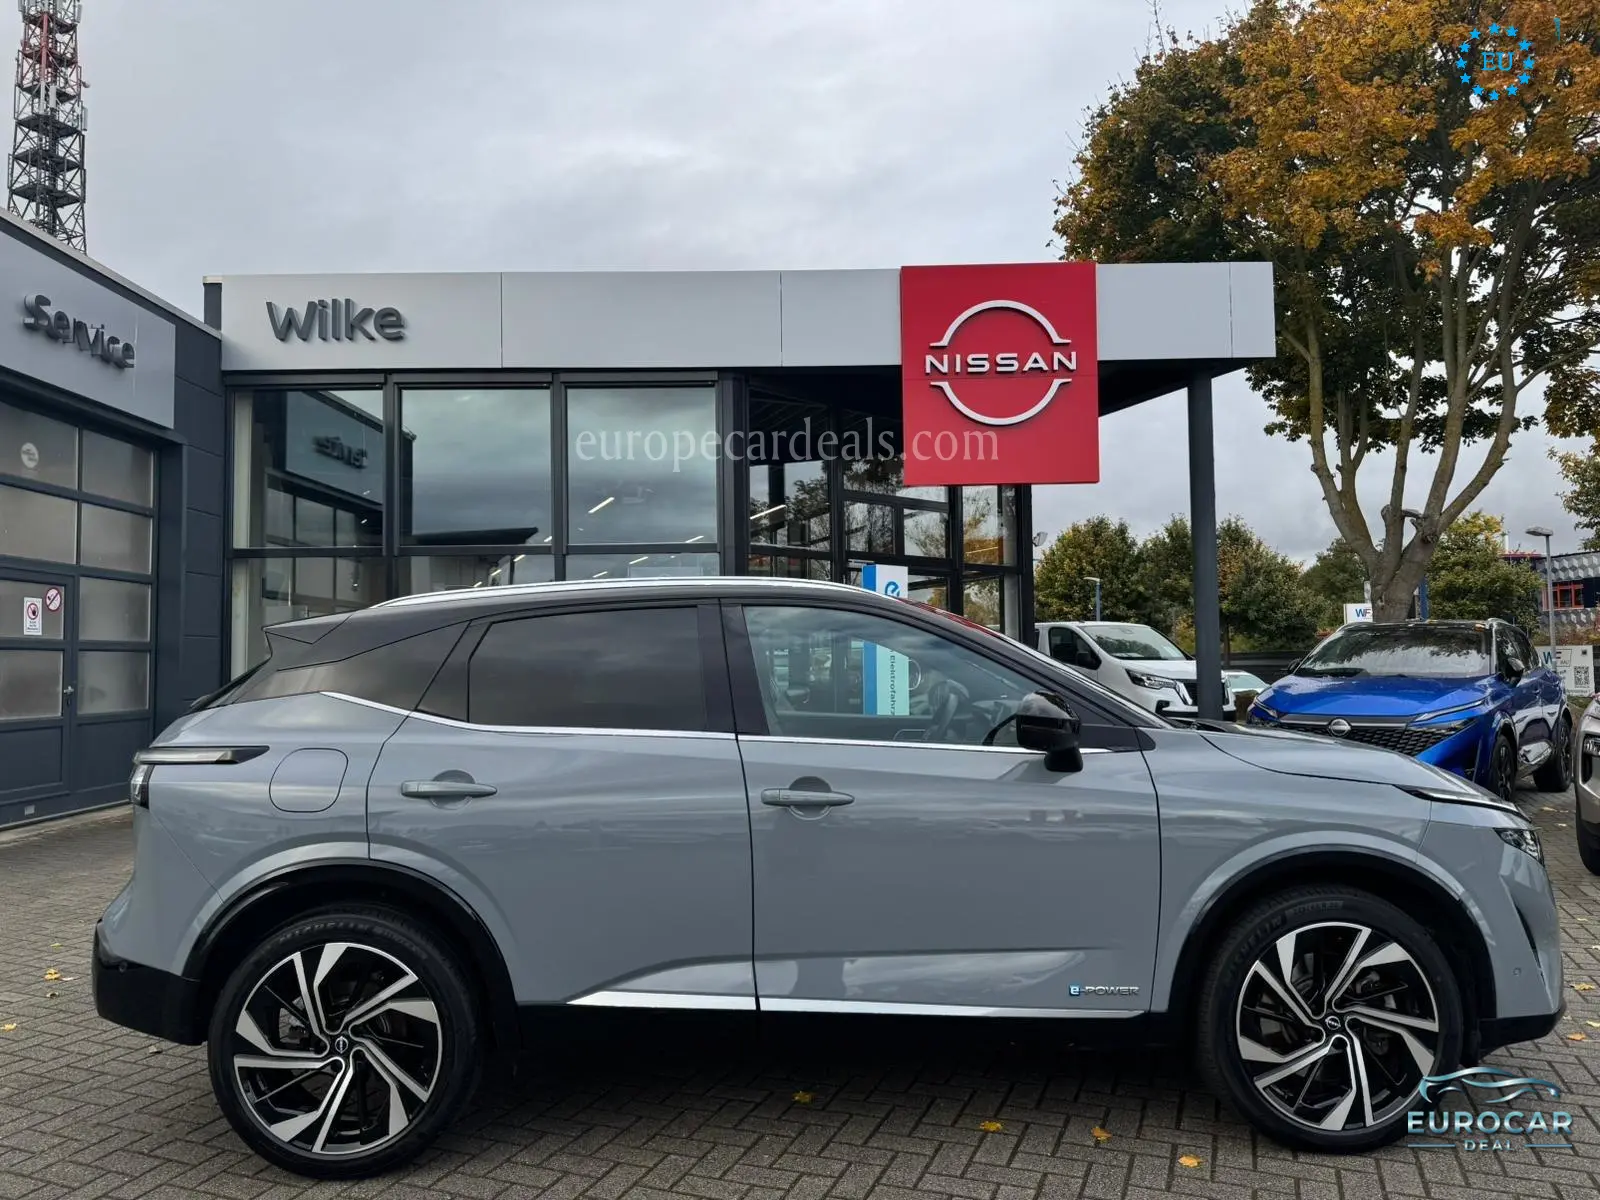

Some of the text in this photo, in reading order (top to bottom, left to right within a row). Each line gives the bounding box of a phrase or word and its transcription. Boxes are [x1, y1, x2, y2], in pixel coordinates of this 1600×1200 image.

[24, 294, 135, 369] Service
[265, 298, 405, 341] Wilke
[925, 351, 1077, 374] NISSAN
